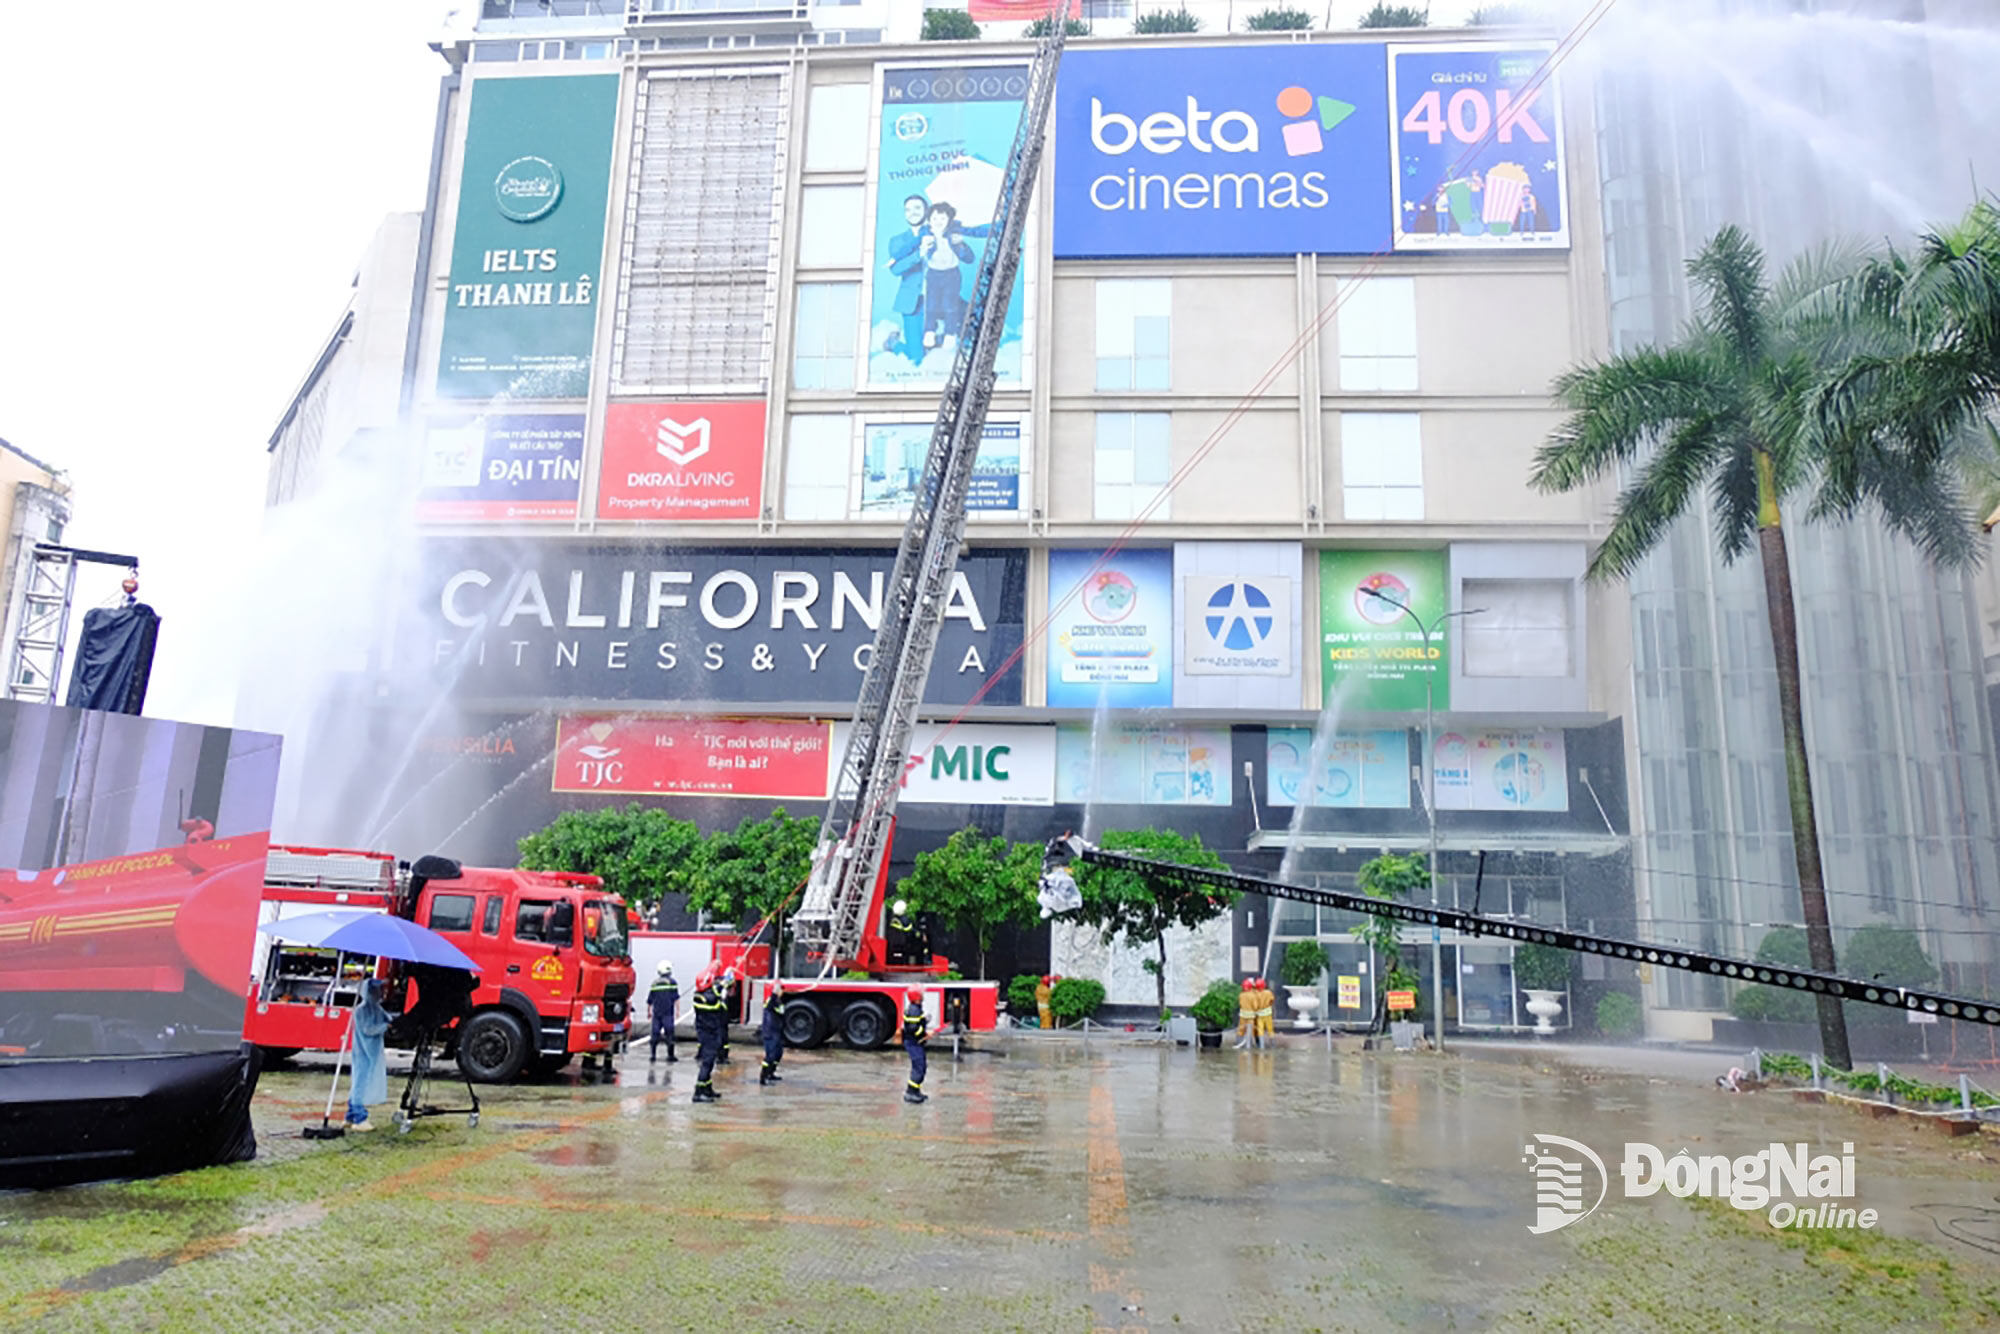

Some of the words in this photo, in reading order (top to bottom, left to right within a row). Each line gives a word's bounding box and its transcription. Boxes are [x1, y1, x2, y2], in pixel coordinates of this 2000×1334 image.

[1090, 95, 1259, 155] beta
[1402, 87, 1550, 144] 40K
[1090, 167, 1329, 211] cinemas
[483, 248, 558, 272] IELTS
[455, 282, 554, 307] THANH
[557, 273, 593, 305] LÊ
[488, 459, 533, 486] ĐẠI
[539, 455, 580, 481] TÍN
[609, 497, 664, 510] Property
[665, 497, 749, 510] Management
[440, 569, 987, 631] CALIFORNA
[434, 641, 724, 670] FITNESS
[752, 643, 774, 671] &
[802, 643, 986, 673] YOA
[1330, 648, 1369, 660] KIDS
[1375, 648, 1440, 660] WORLD
[575, 761, 623, 787] TJC
[930, 744, 1011, 781] MIC
